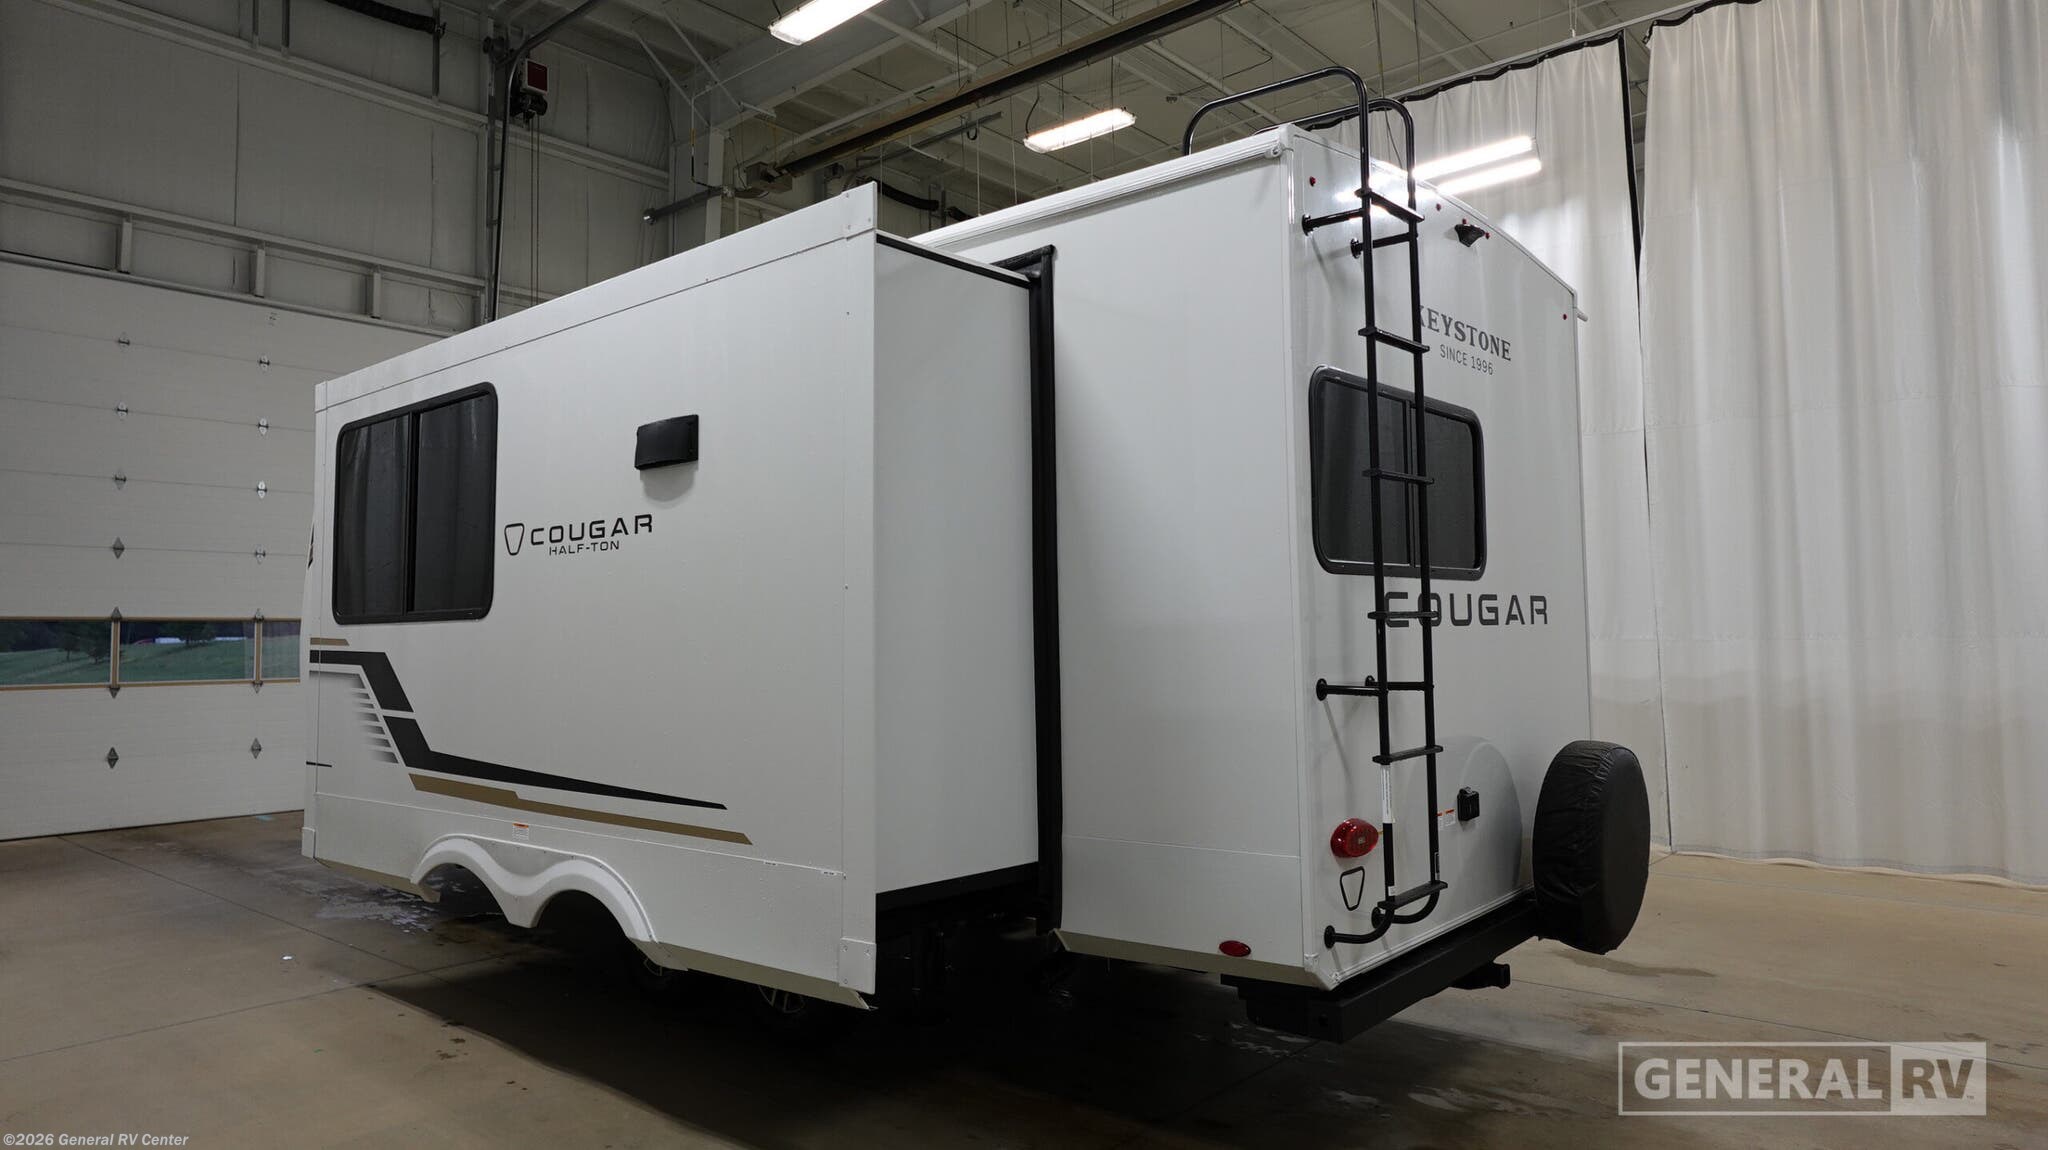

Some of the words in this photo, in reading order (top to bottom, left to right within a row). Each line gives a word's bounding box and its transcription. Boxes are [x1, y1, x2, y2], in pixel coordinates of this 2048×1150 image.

[1440, 344, 1468, 366] SINCE
[1471, 356, 1494, 375] 1996
[531, 514, 653, 545] COUGAR
[549, 540, 620, 556] HALF-TON
[1384, 591, 1548, 628] COUGAR
